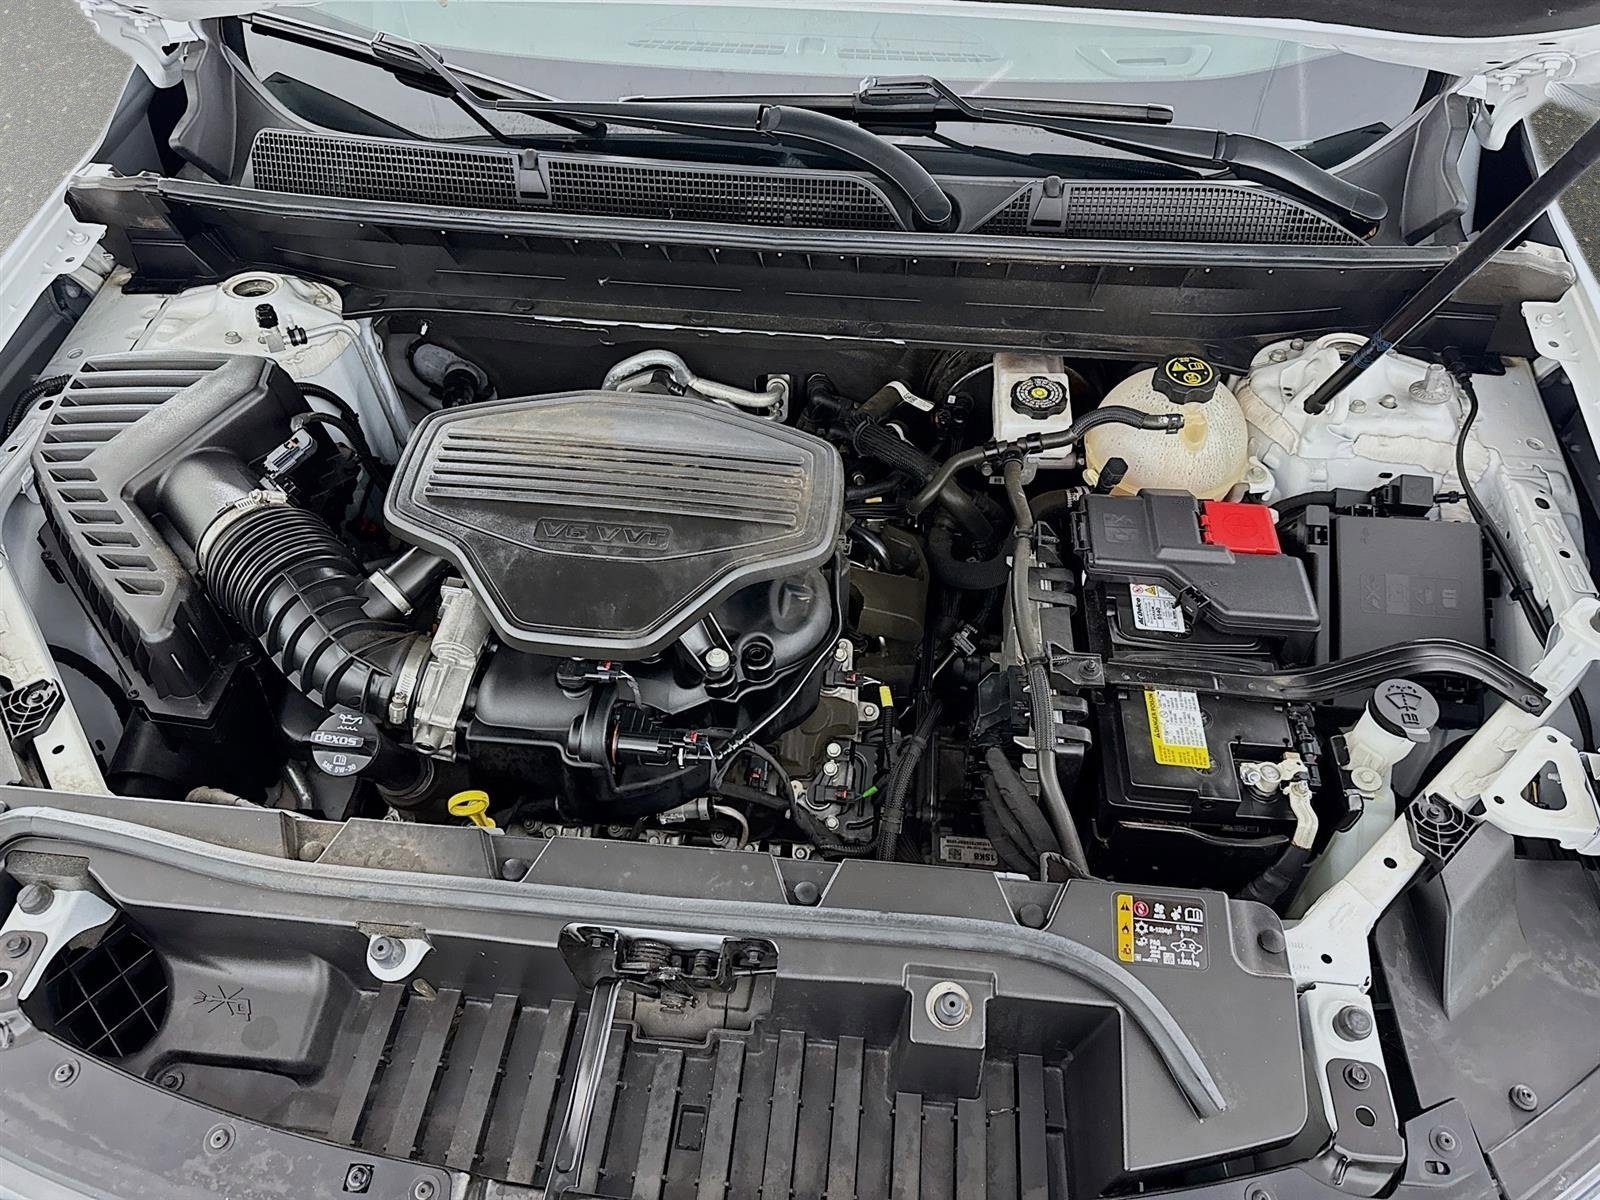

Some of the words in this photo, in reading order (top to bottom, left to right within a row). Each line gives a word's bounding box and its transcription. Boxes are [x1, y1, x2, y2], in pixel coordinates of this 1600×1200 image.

[542, 521, 588, 539] V6
[596, 525, 668, 545] VVT
[1136, 597, 1144, 625] ACDelco
[1148, 693, 1156, 712] POISON
[1151, 713, 1160, 733] DANGER
[314, 731, 357, 746] dexos
[321, 760, 333, 772] SAE
[334, 764, 356, 773] 5W-30
